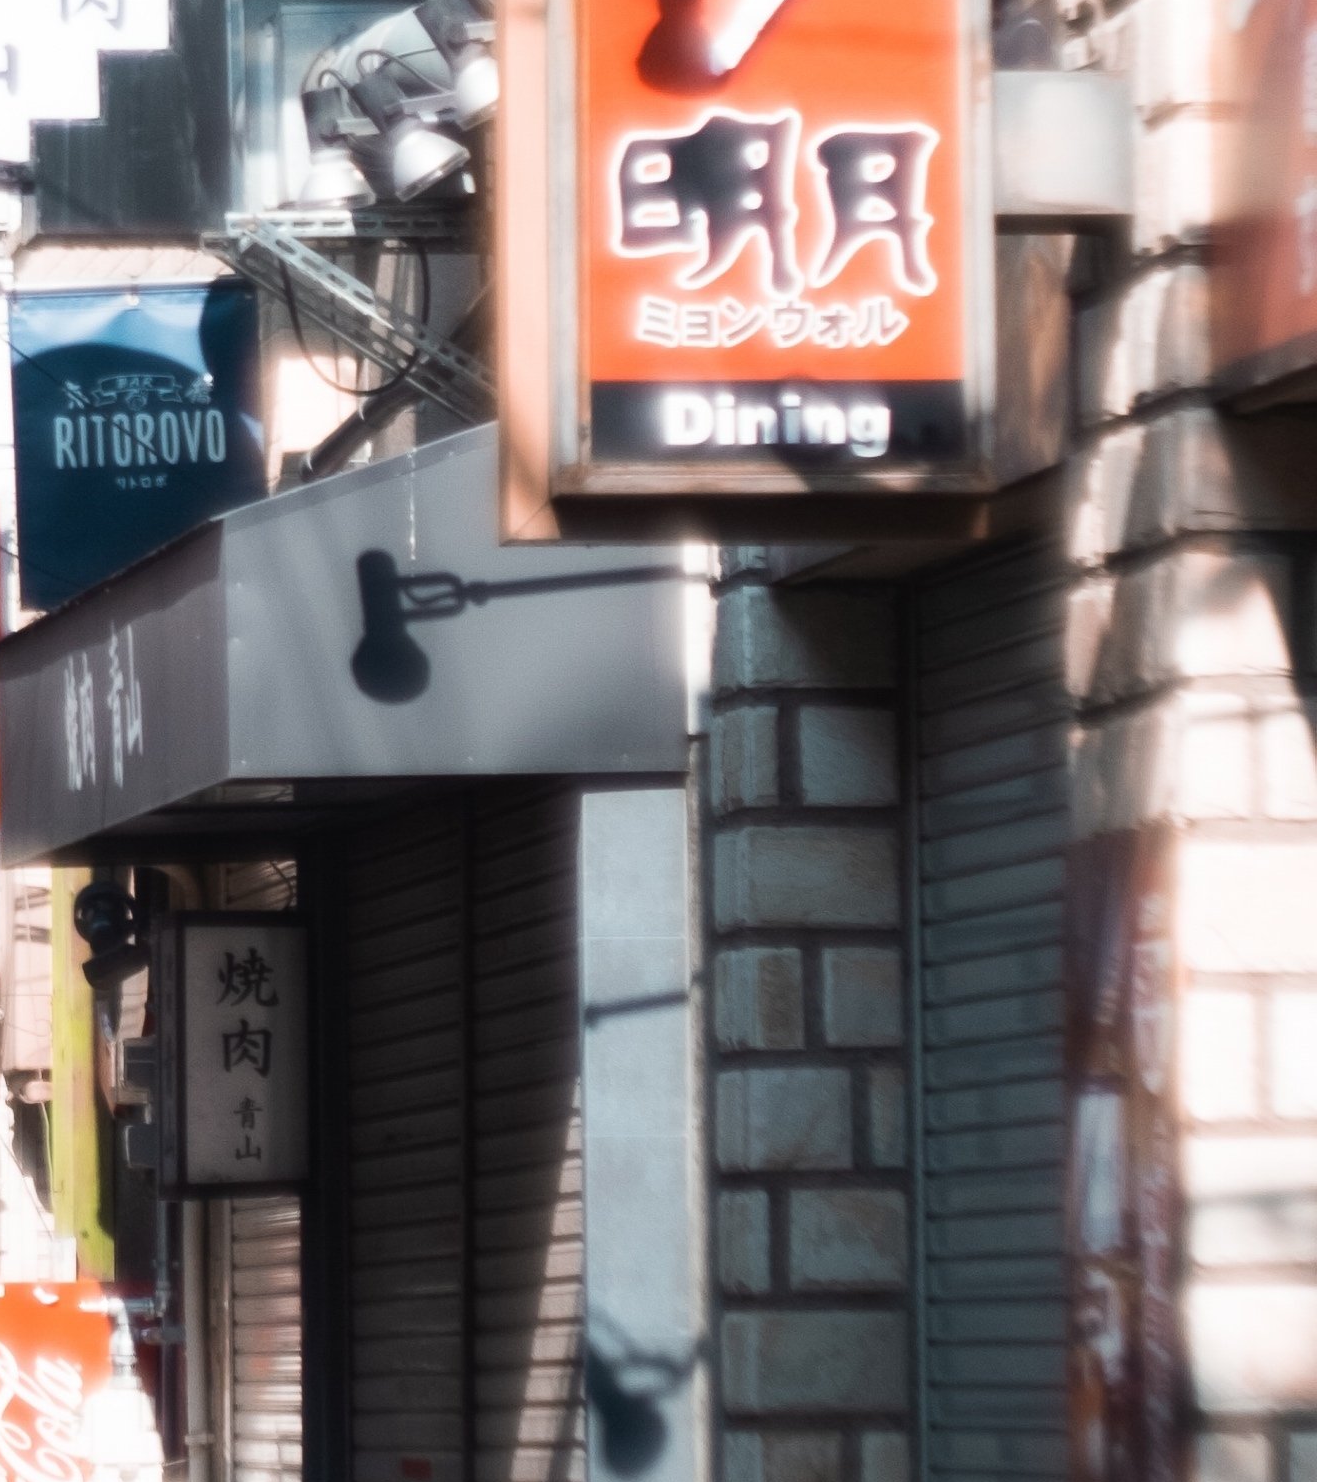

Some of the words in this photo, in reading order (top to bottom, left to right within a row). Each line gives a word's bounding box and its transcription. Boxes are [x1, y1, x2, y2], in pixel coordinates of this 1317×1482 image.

[613, 107, 938, 296] 明月
[636, 295, 910, 349] ミョンウォル
[53, 408, 227, 470] RITOROVO
[664, 390, 891, 458] Dining
[215, 946, 281, 1083] 焼肉
[232, 1096, 264, 1163] 青山
